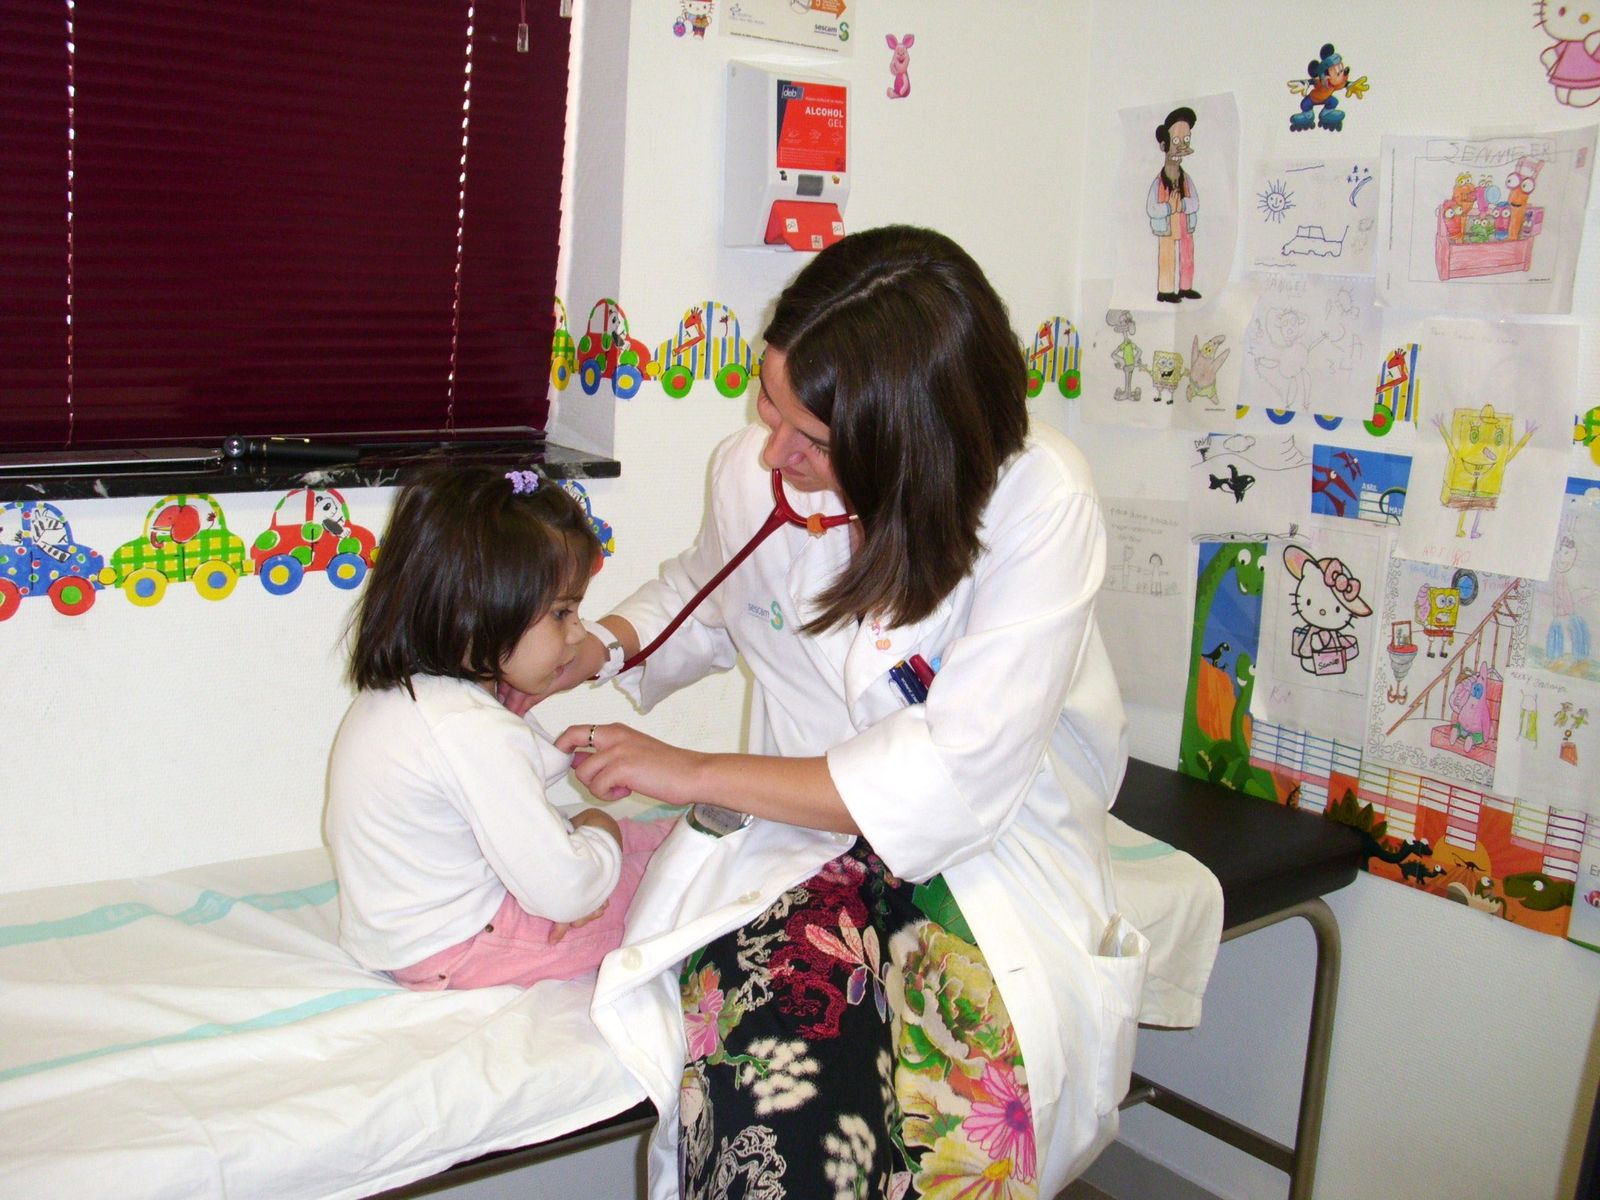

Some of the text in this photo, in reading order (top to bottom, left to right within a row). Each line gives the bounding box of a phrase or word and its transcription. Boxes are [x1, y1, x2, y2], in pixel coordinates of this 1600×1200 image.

[814, 23, 838, 33] sescam
[805, 106, 844, 118] ALCOHOL
[828, 118, 844, 128] GEL
